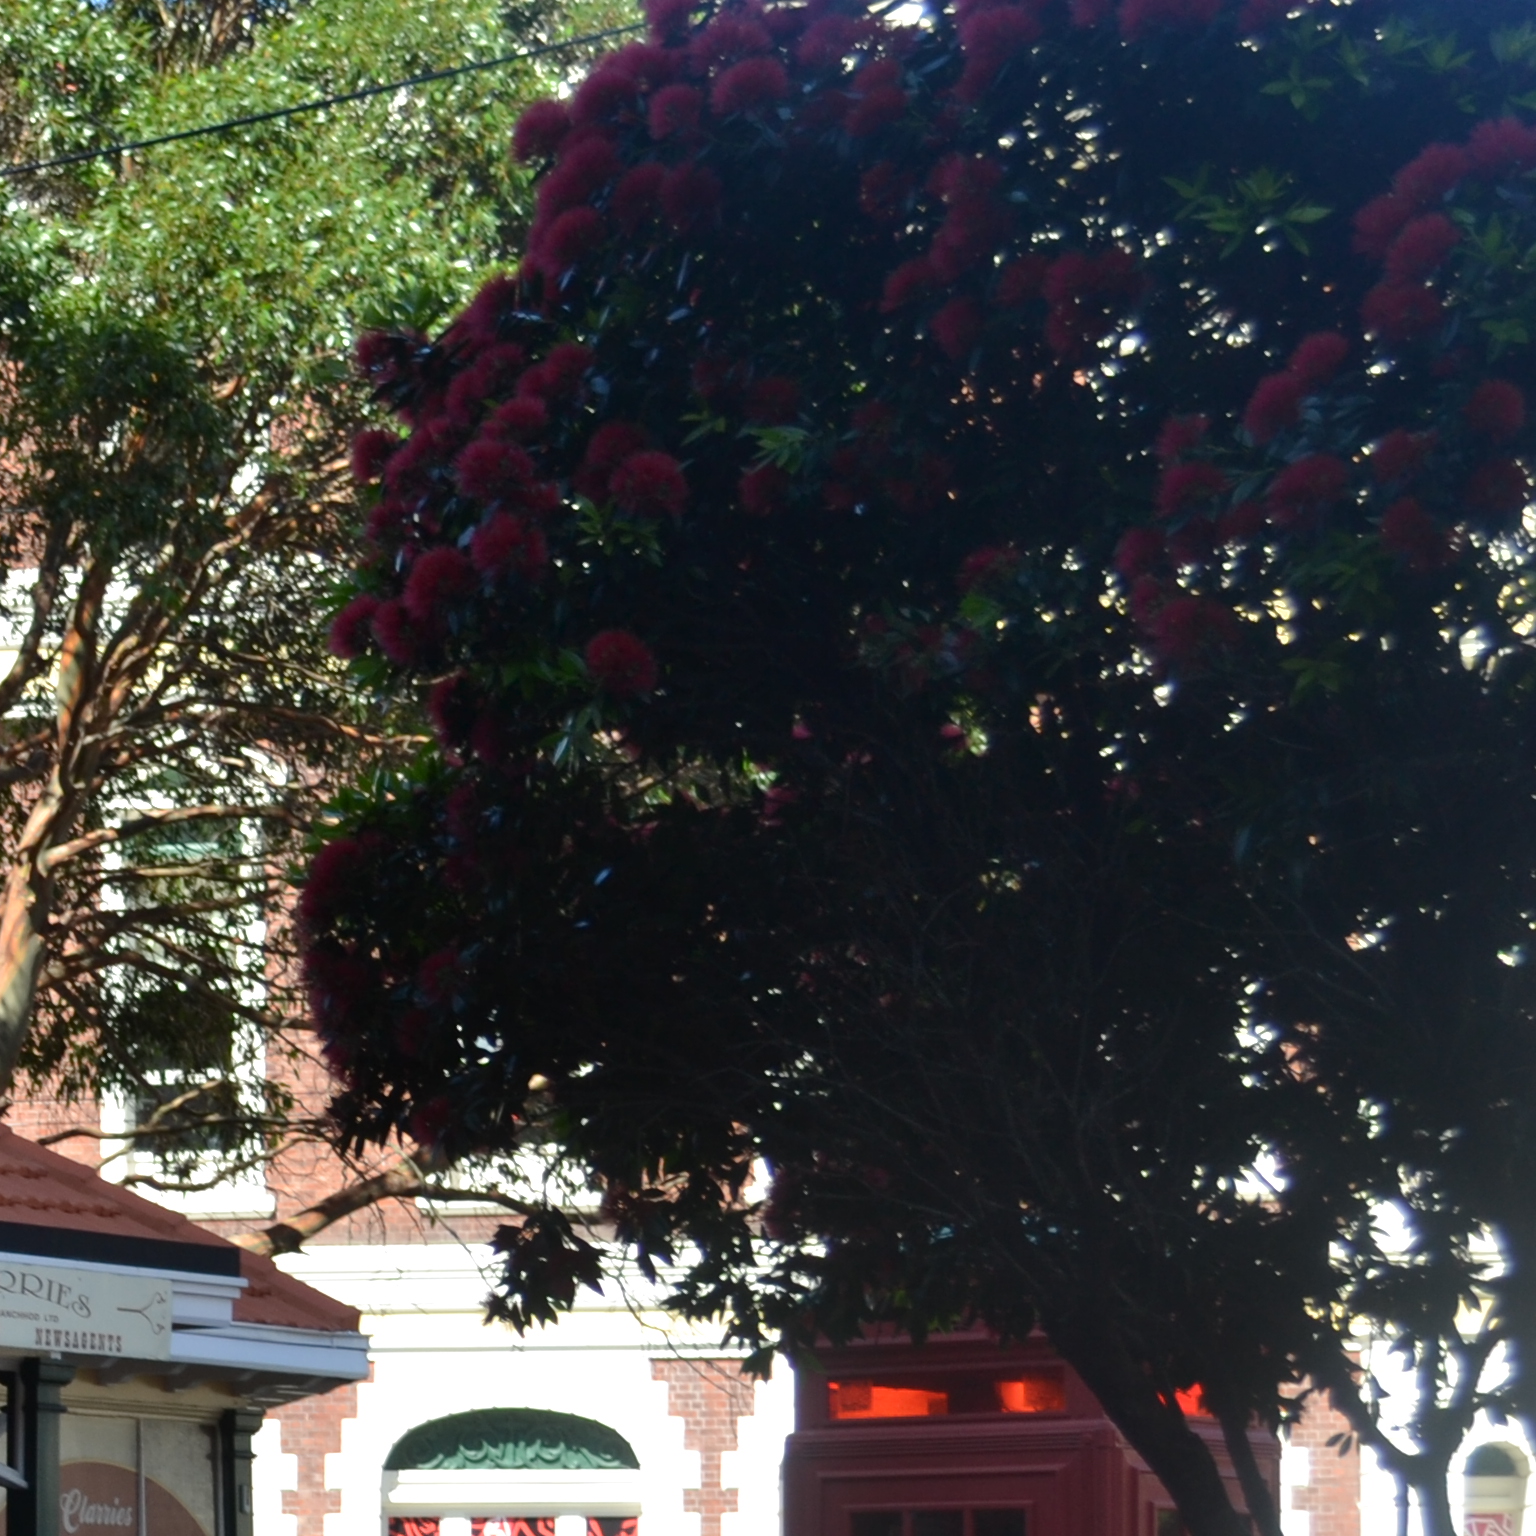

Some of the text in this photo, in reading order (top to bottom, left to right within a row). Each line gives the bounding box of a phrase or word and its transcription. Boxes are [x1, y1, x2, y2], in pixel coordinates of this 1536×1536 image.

[44, 1314, 59, 1323] LTD
[35, 1327, 122, 1353] NEWSAGENTS
[59, 1488, 134, 1534] Clarries
